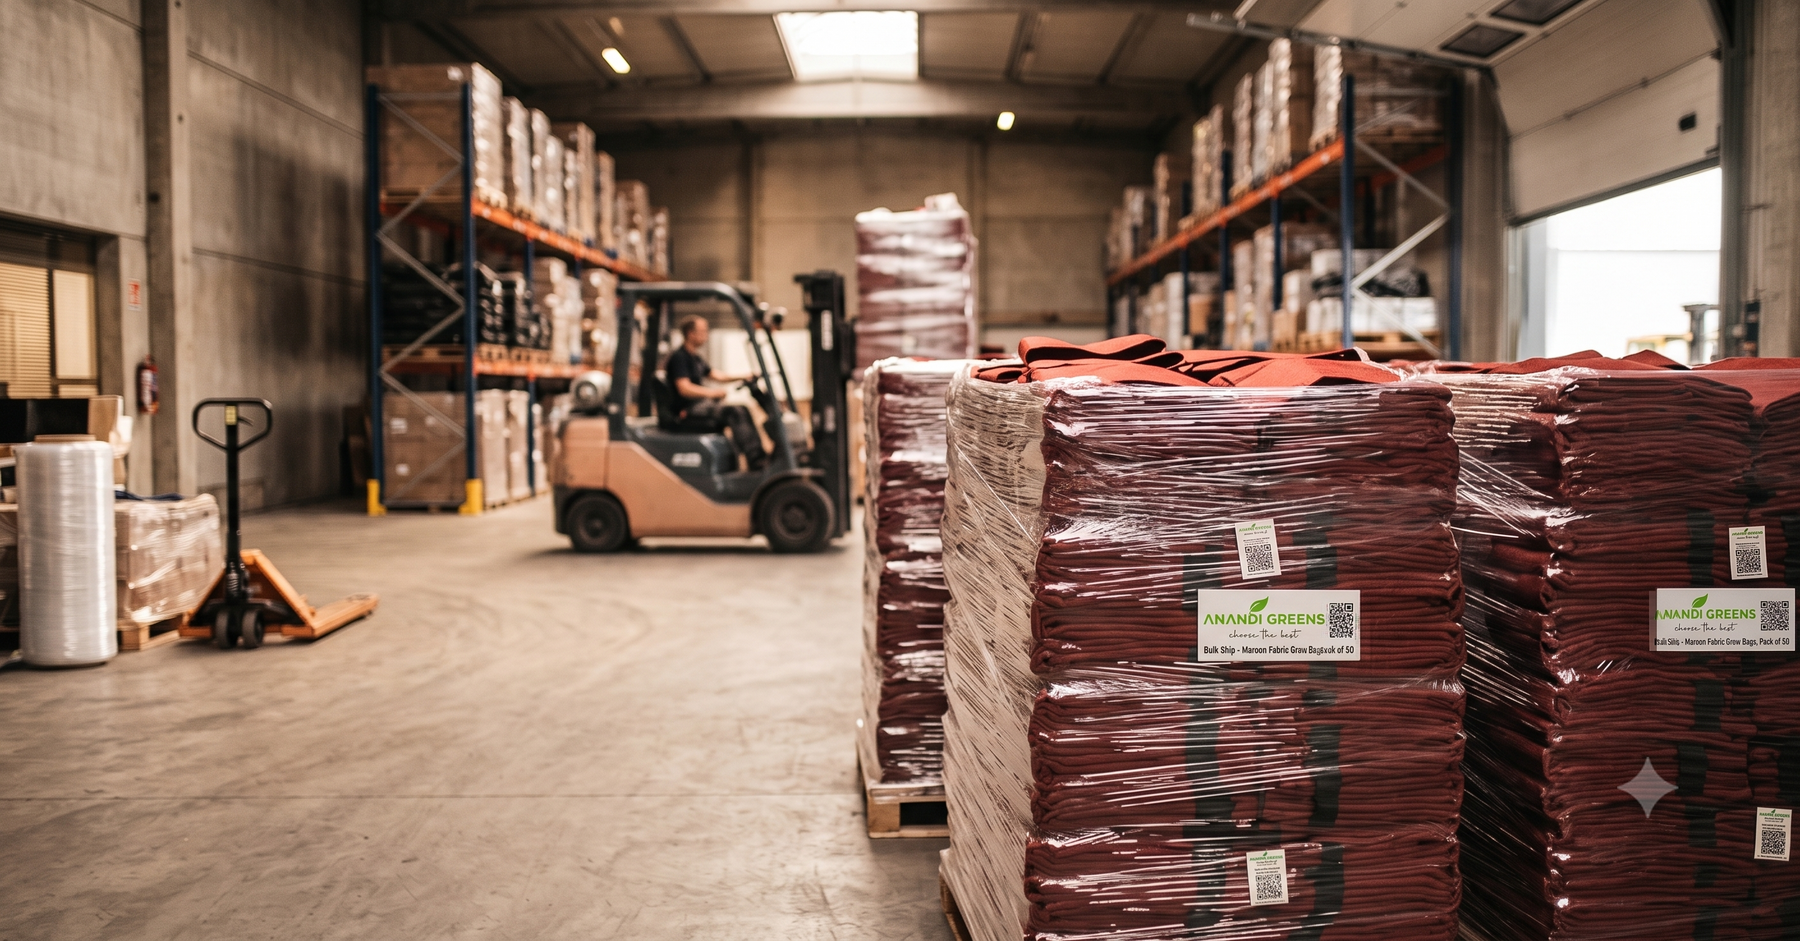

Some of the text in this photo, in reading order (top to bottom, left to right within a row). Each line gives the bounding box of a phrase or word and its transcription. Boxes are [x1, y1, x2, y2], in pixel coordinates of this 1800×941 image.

[1203, 613, 1325, 625] ANANDI GREENS
[1706, 608, 1757, 620] GREENS
[1675, 622, 1738, 633] choose the best
[1228, 628, 1302, 640] choose the best
[1684, 637, 1707, 646] Maroon
[1707, 637, 1725, 646] Fabric
[1725, 637, 1741, 646] Grow
[1742, 637, 1758, 648] Bags,
[1759, 637, 1774, 646] Pack
[1774, 637, 1781, 646] of
[1781, 637, 1790, 646] 50
[1203, 645, 1219, 654] Bulk
[1220, 645, 1236, 656] Ship
[1241, 645, 1268, 654] Maroon
[1268, 645, 1290, 654] Fabric
[1336, 645, 1345, 654] of
[1345, 645, 1355, 654] 50
